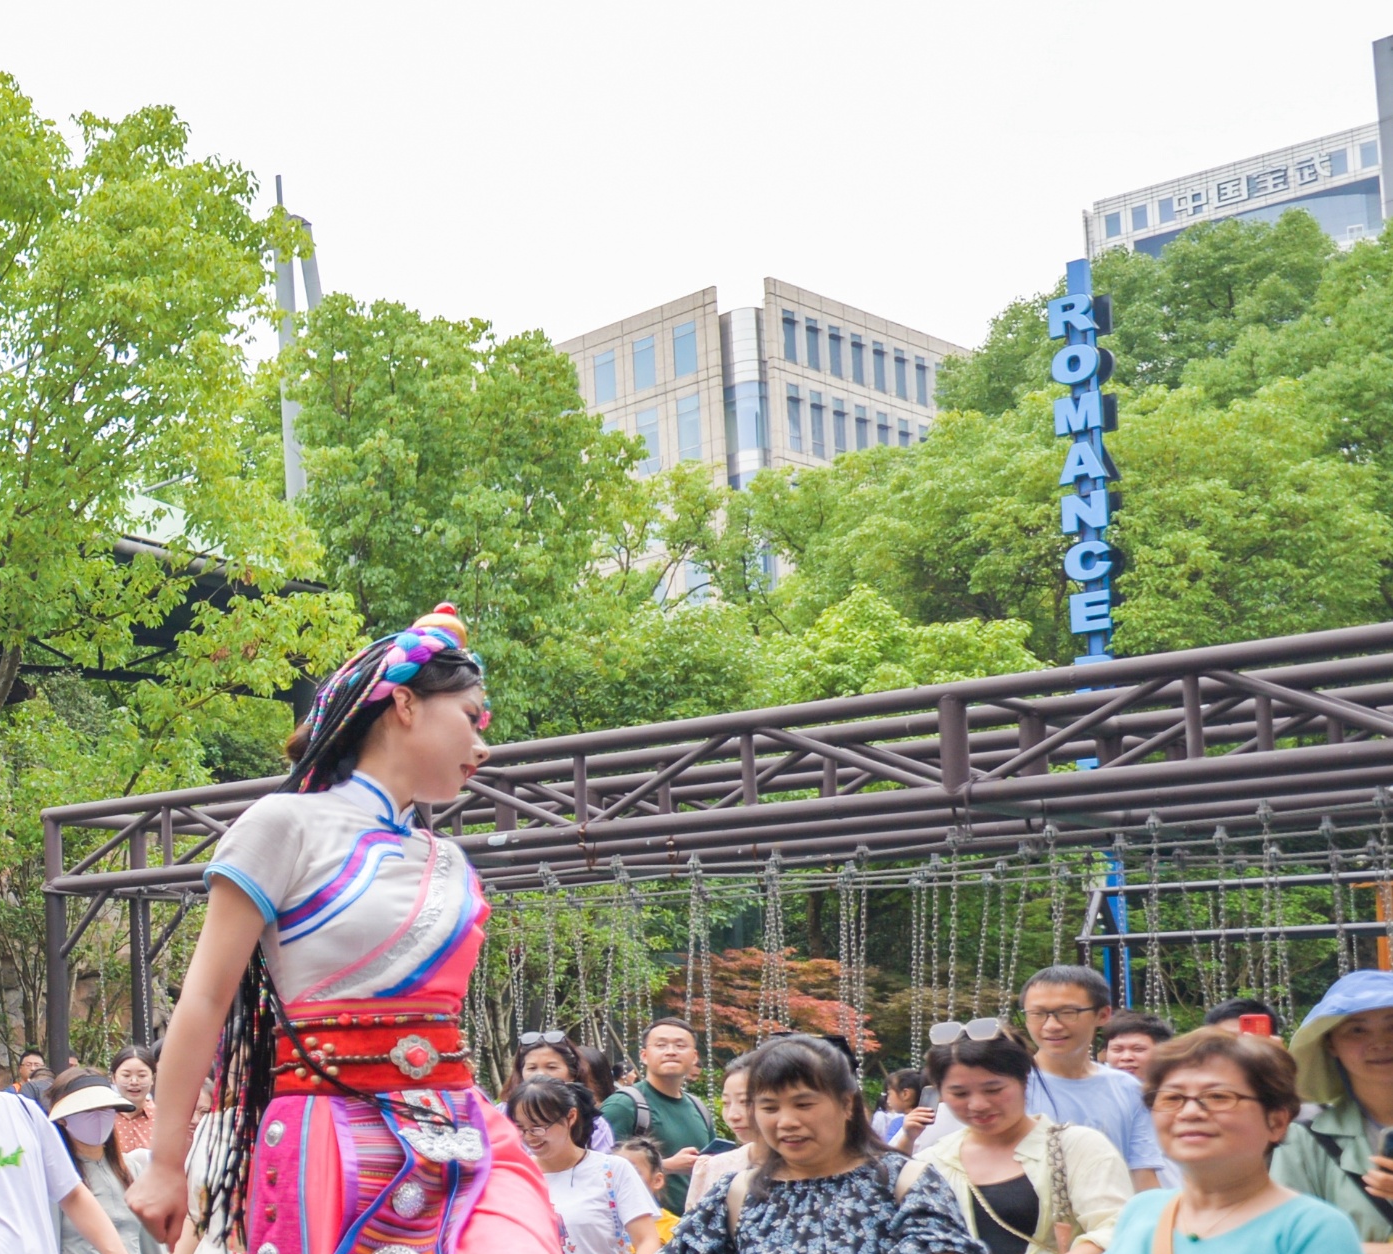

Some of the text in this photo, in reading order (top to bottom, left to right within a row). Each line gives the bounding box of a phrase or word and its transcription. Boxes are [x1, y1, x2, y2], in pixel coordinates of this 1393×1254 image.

[1173, 152, 1332, 216] 中国宝武
[1047, 293, 1113, 634] ROMANCE
